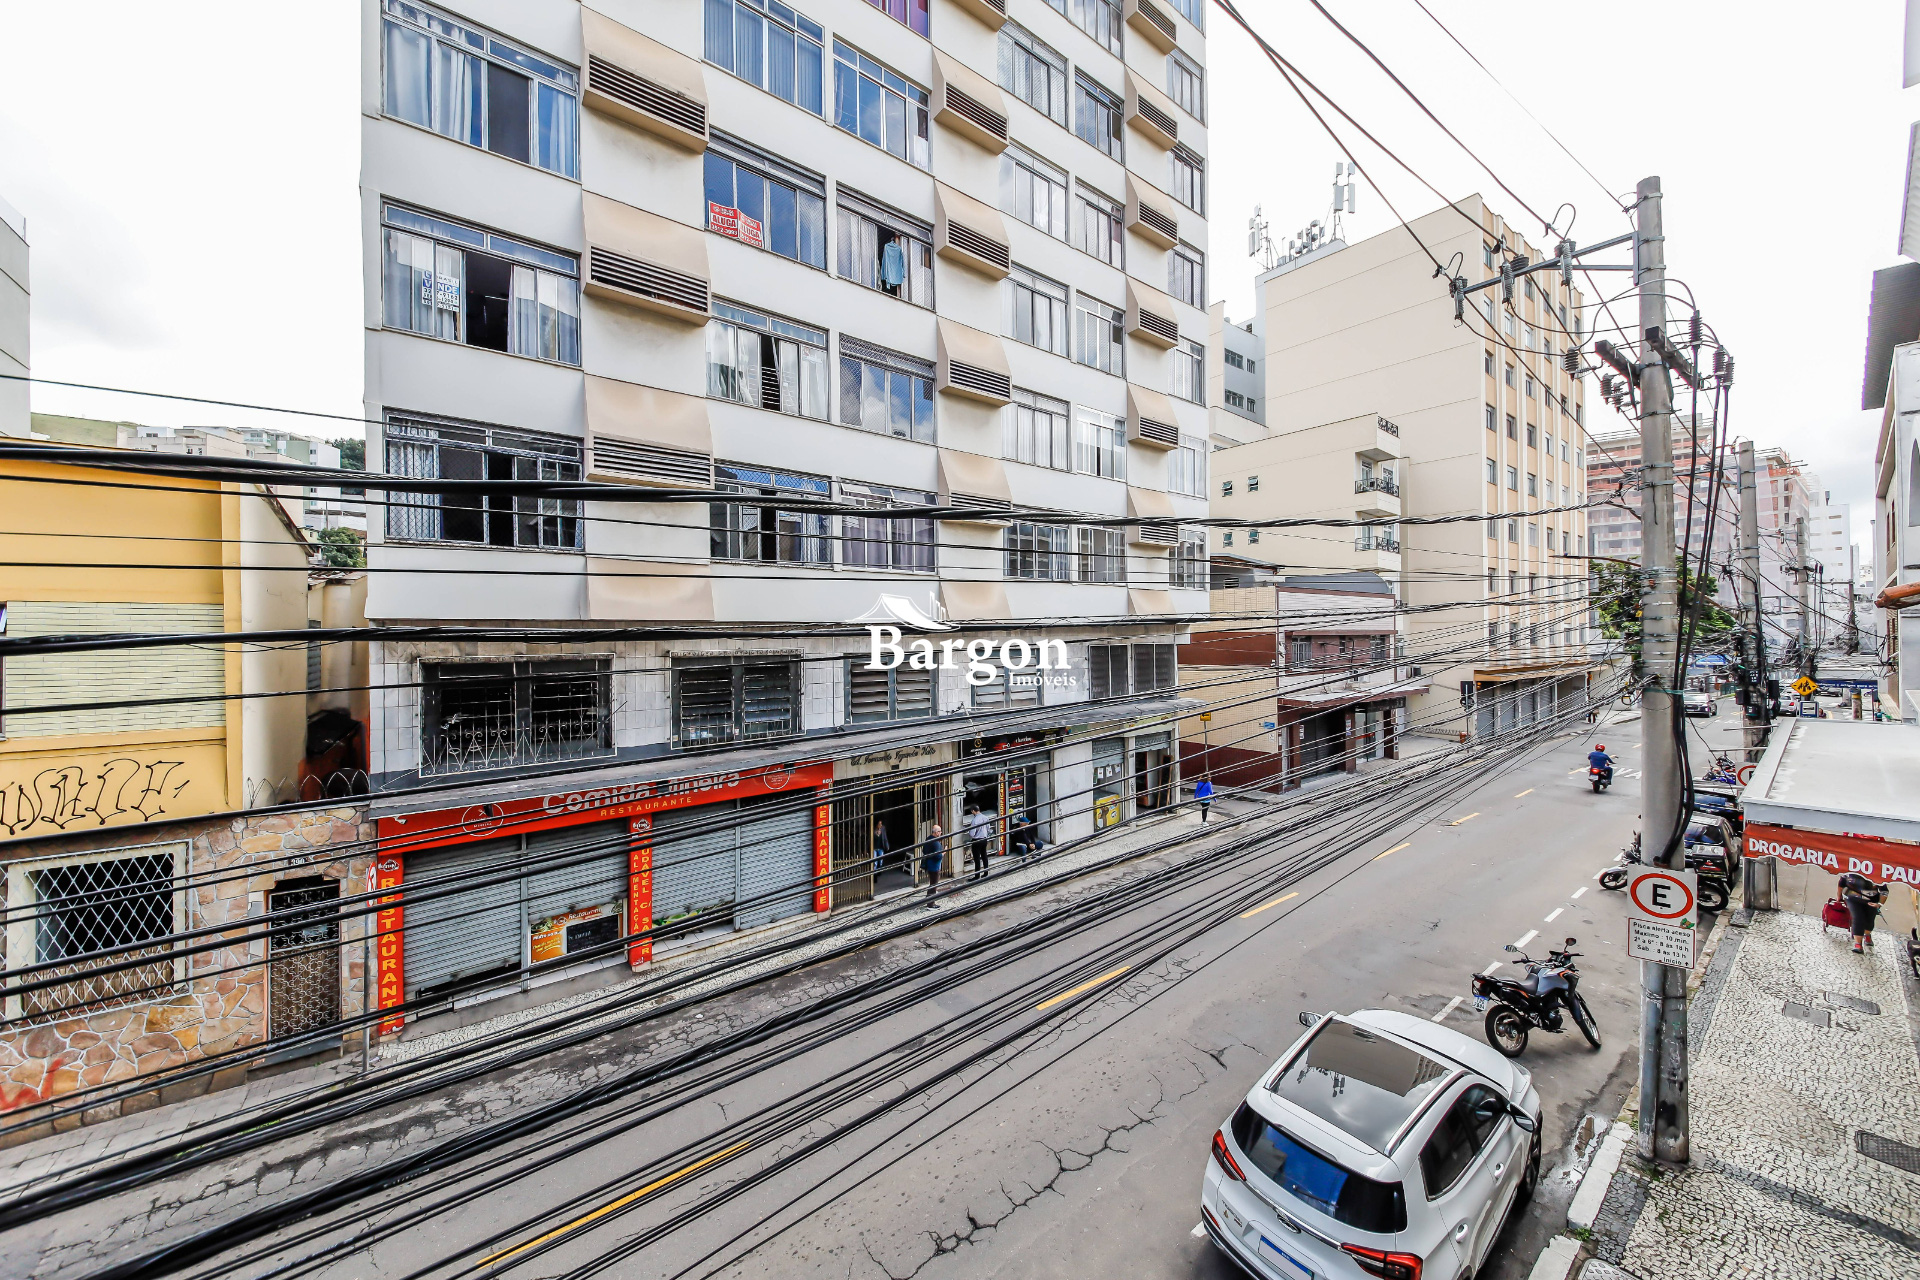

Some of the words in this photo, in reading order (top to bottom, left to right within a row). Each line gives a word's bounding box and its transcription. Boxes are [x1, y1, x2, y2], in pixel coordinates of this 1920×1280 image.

[712, 215, 736, 228] ALUGA
[424, 280, 459, 295] VNDE
[542, 784, 650, 814] Comida
[600, 796, 692, 816] RESTAURANTE
[1748, 838, 1839, 869] DROGARIA
[1848, 857, 1873, 875] DO
[1652, 883, 1671, 908] E
[641, 917, 650, 954] SAOR
[1633, 921, 1651, 930] Pisca
[1652, 924, 1670, 934] alerta
[1671, 930, 1691, 938] aceso
